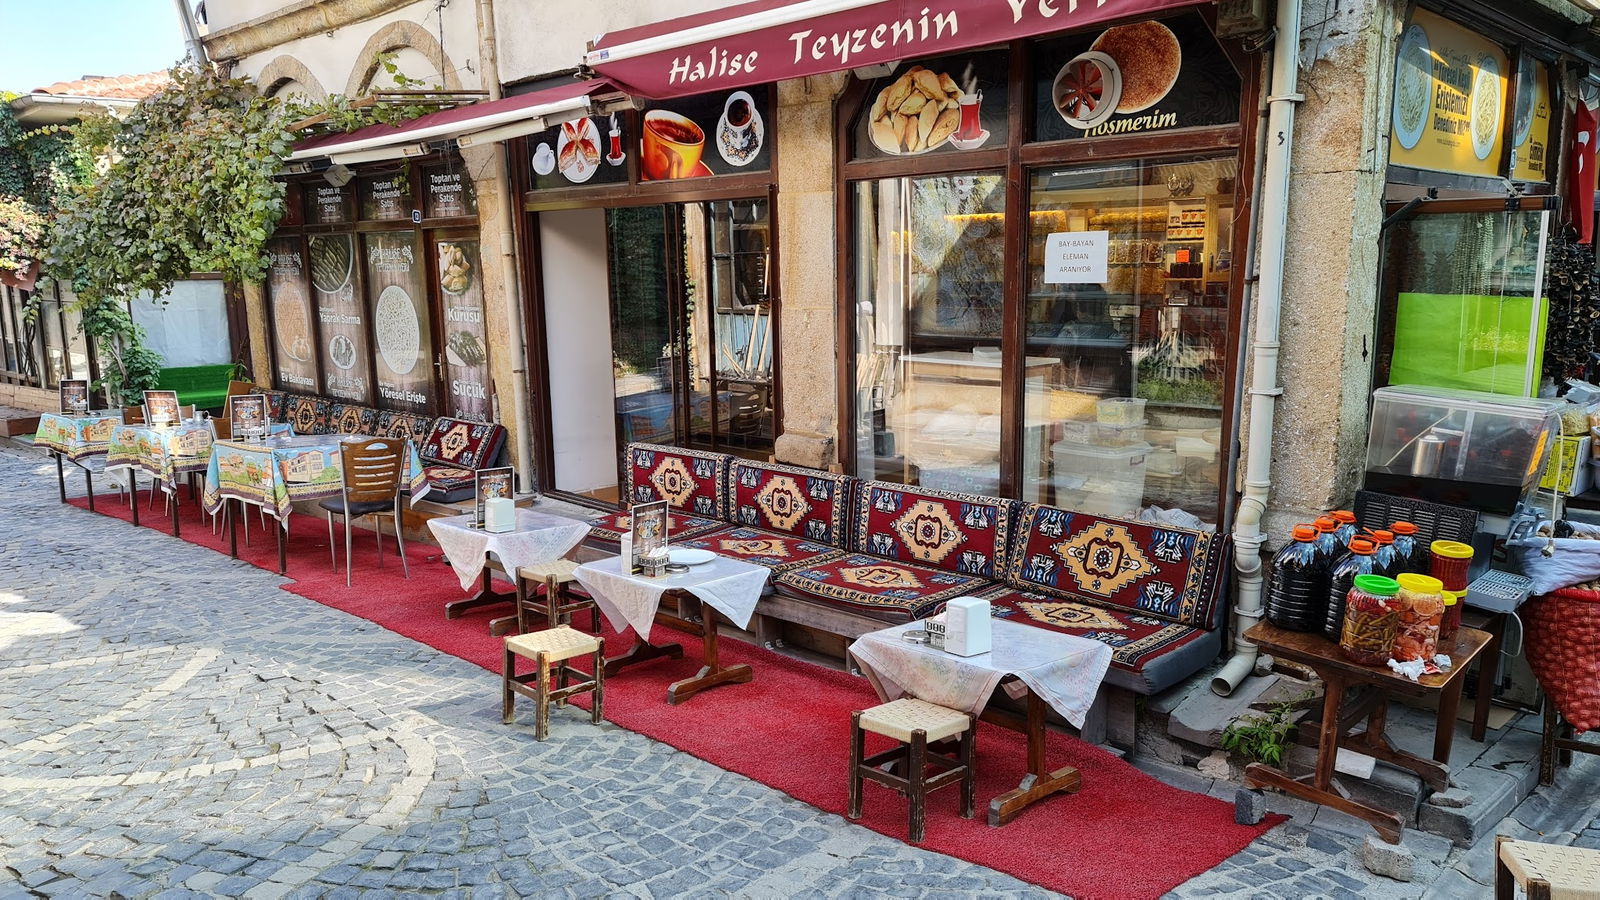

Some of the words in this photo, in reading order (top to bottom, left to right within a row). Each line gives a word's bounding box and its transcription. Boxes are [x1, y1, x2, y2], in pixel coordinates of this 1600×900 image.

[669, 46, 758, 86] Halise
[789, 7, 960, 64] Teyzenin
[1007, 0, 1106, 24] Ye
[372, 181, 392, 191] Toptan
[430, 174, 451, 189] Toptan
[452, 173, 461, 182] ve
[430, 182, 462, 193] Perakende
[373, 188, 401, 200] Perakende
[317, 195, 342, 205] Perakende
[1058, 239, 1095, 248] BAY-BAYAN
[1062, 253, 1089, 261] ELEMAN
[1059, 265, 1092, 273] ARANIYOR
[319, 313, 340, 325] Yaprak
[341, 314, 361, 325] Sarma
[448, 308, 481, 323] Kurusu
[281, 373, 288, 382] Ev
[452, 380, 486, 400] Sucuk
[379, 387, 406, 401] Yöresel
[406, 391, 427, 405] Erişte
